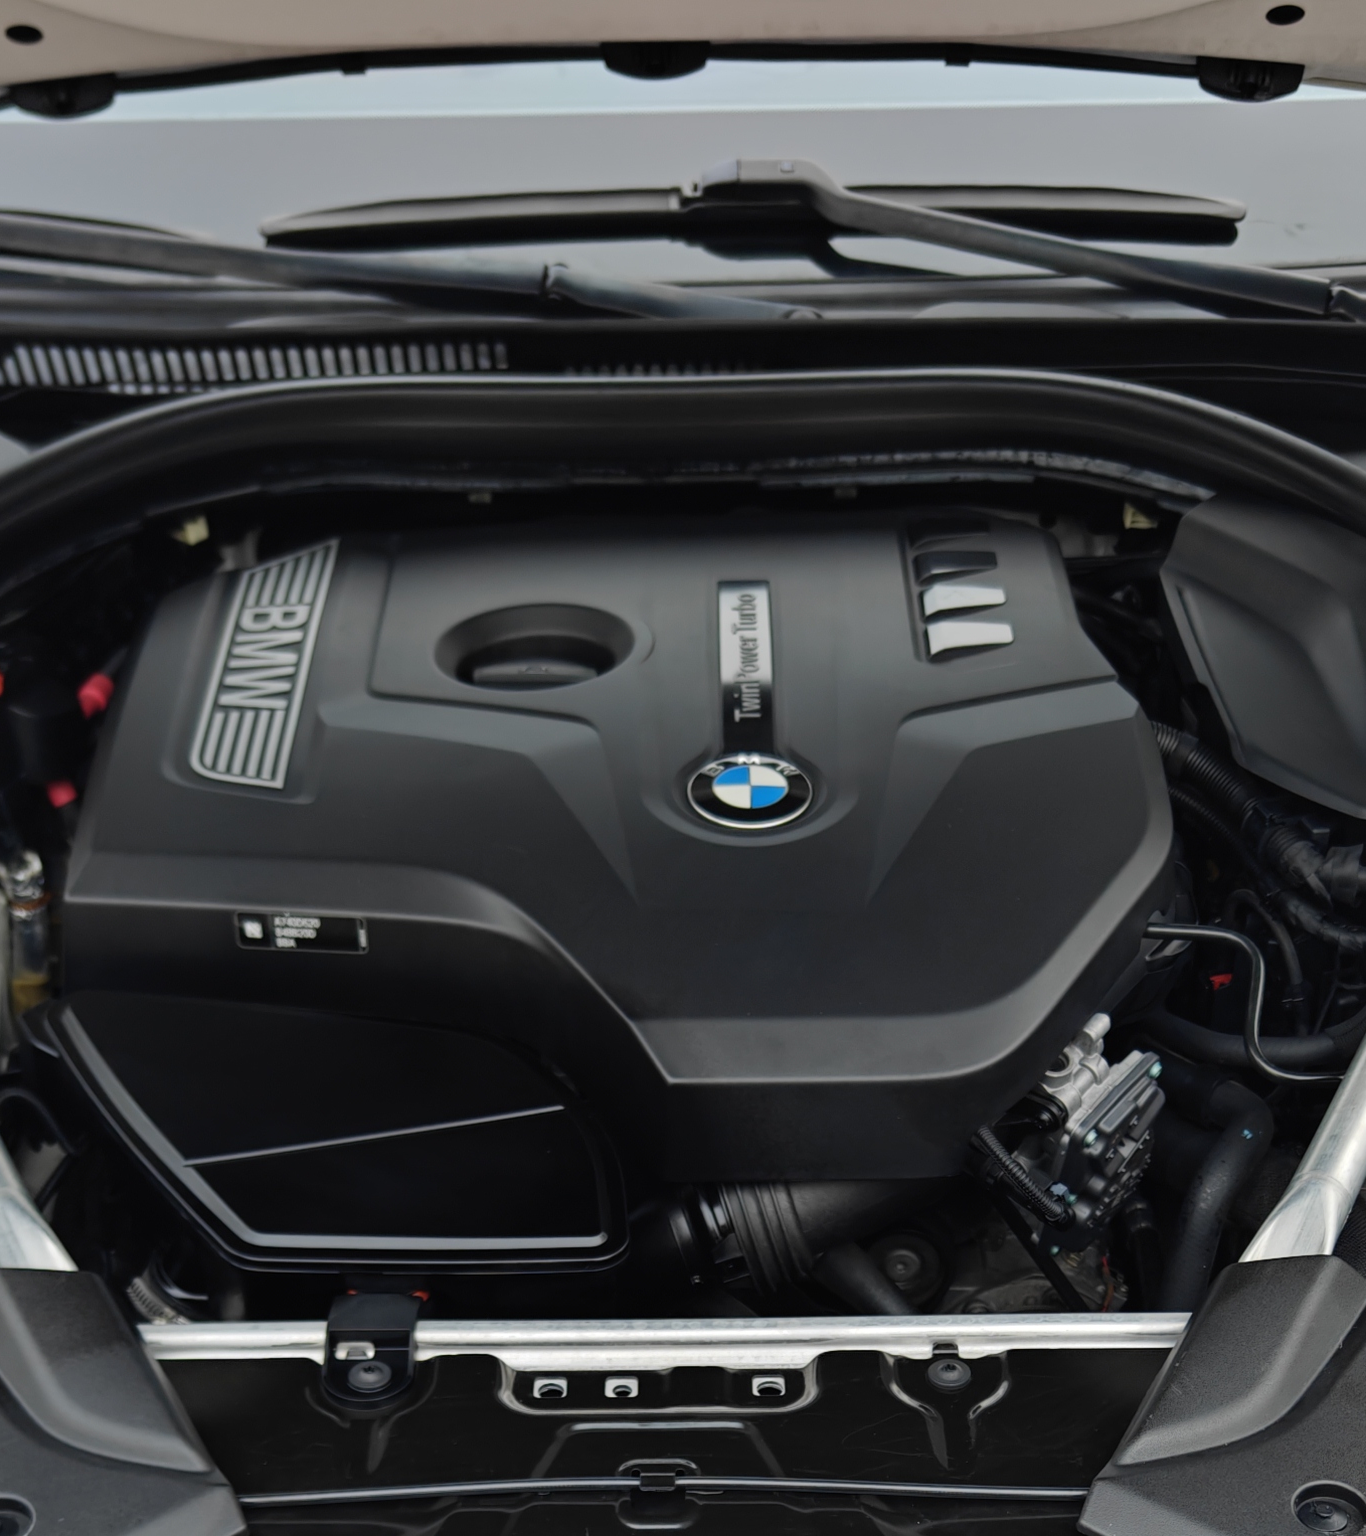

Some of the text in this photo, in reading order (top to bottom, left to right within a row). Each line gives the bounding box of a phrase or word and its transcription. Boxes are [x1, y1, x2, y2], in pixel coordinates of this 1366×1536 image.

[217, 604, 312, 711] BMW
[730, 592, 762, 723] TwinPower Turbo
